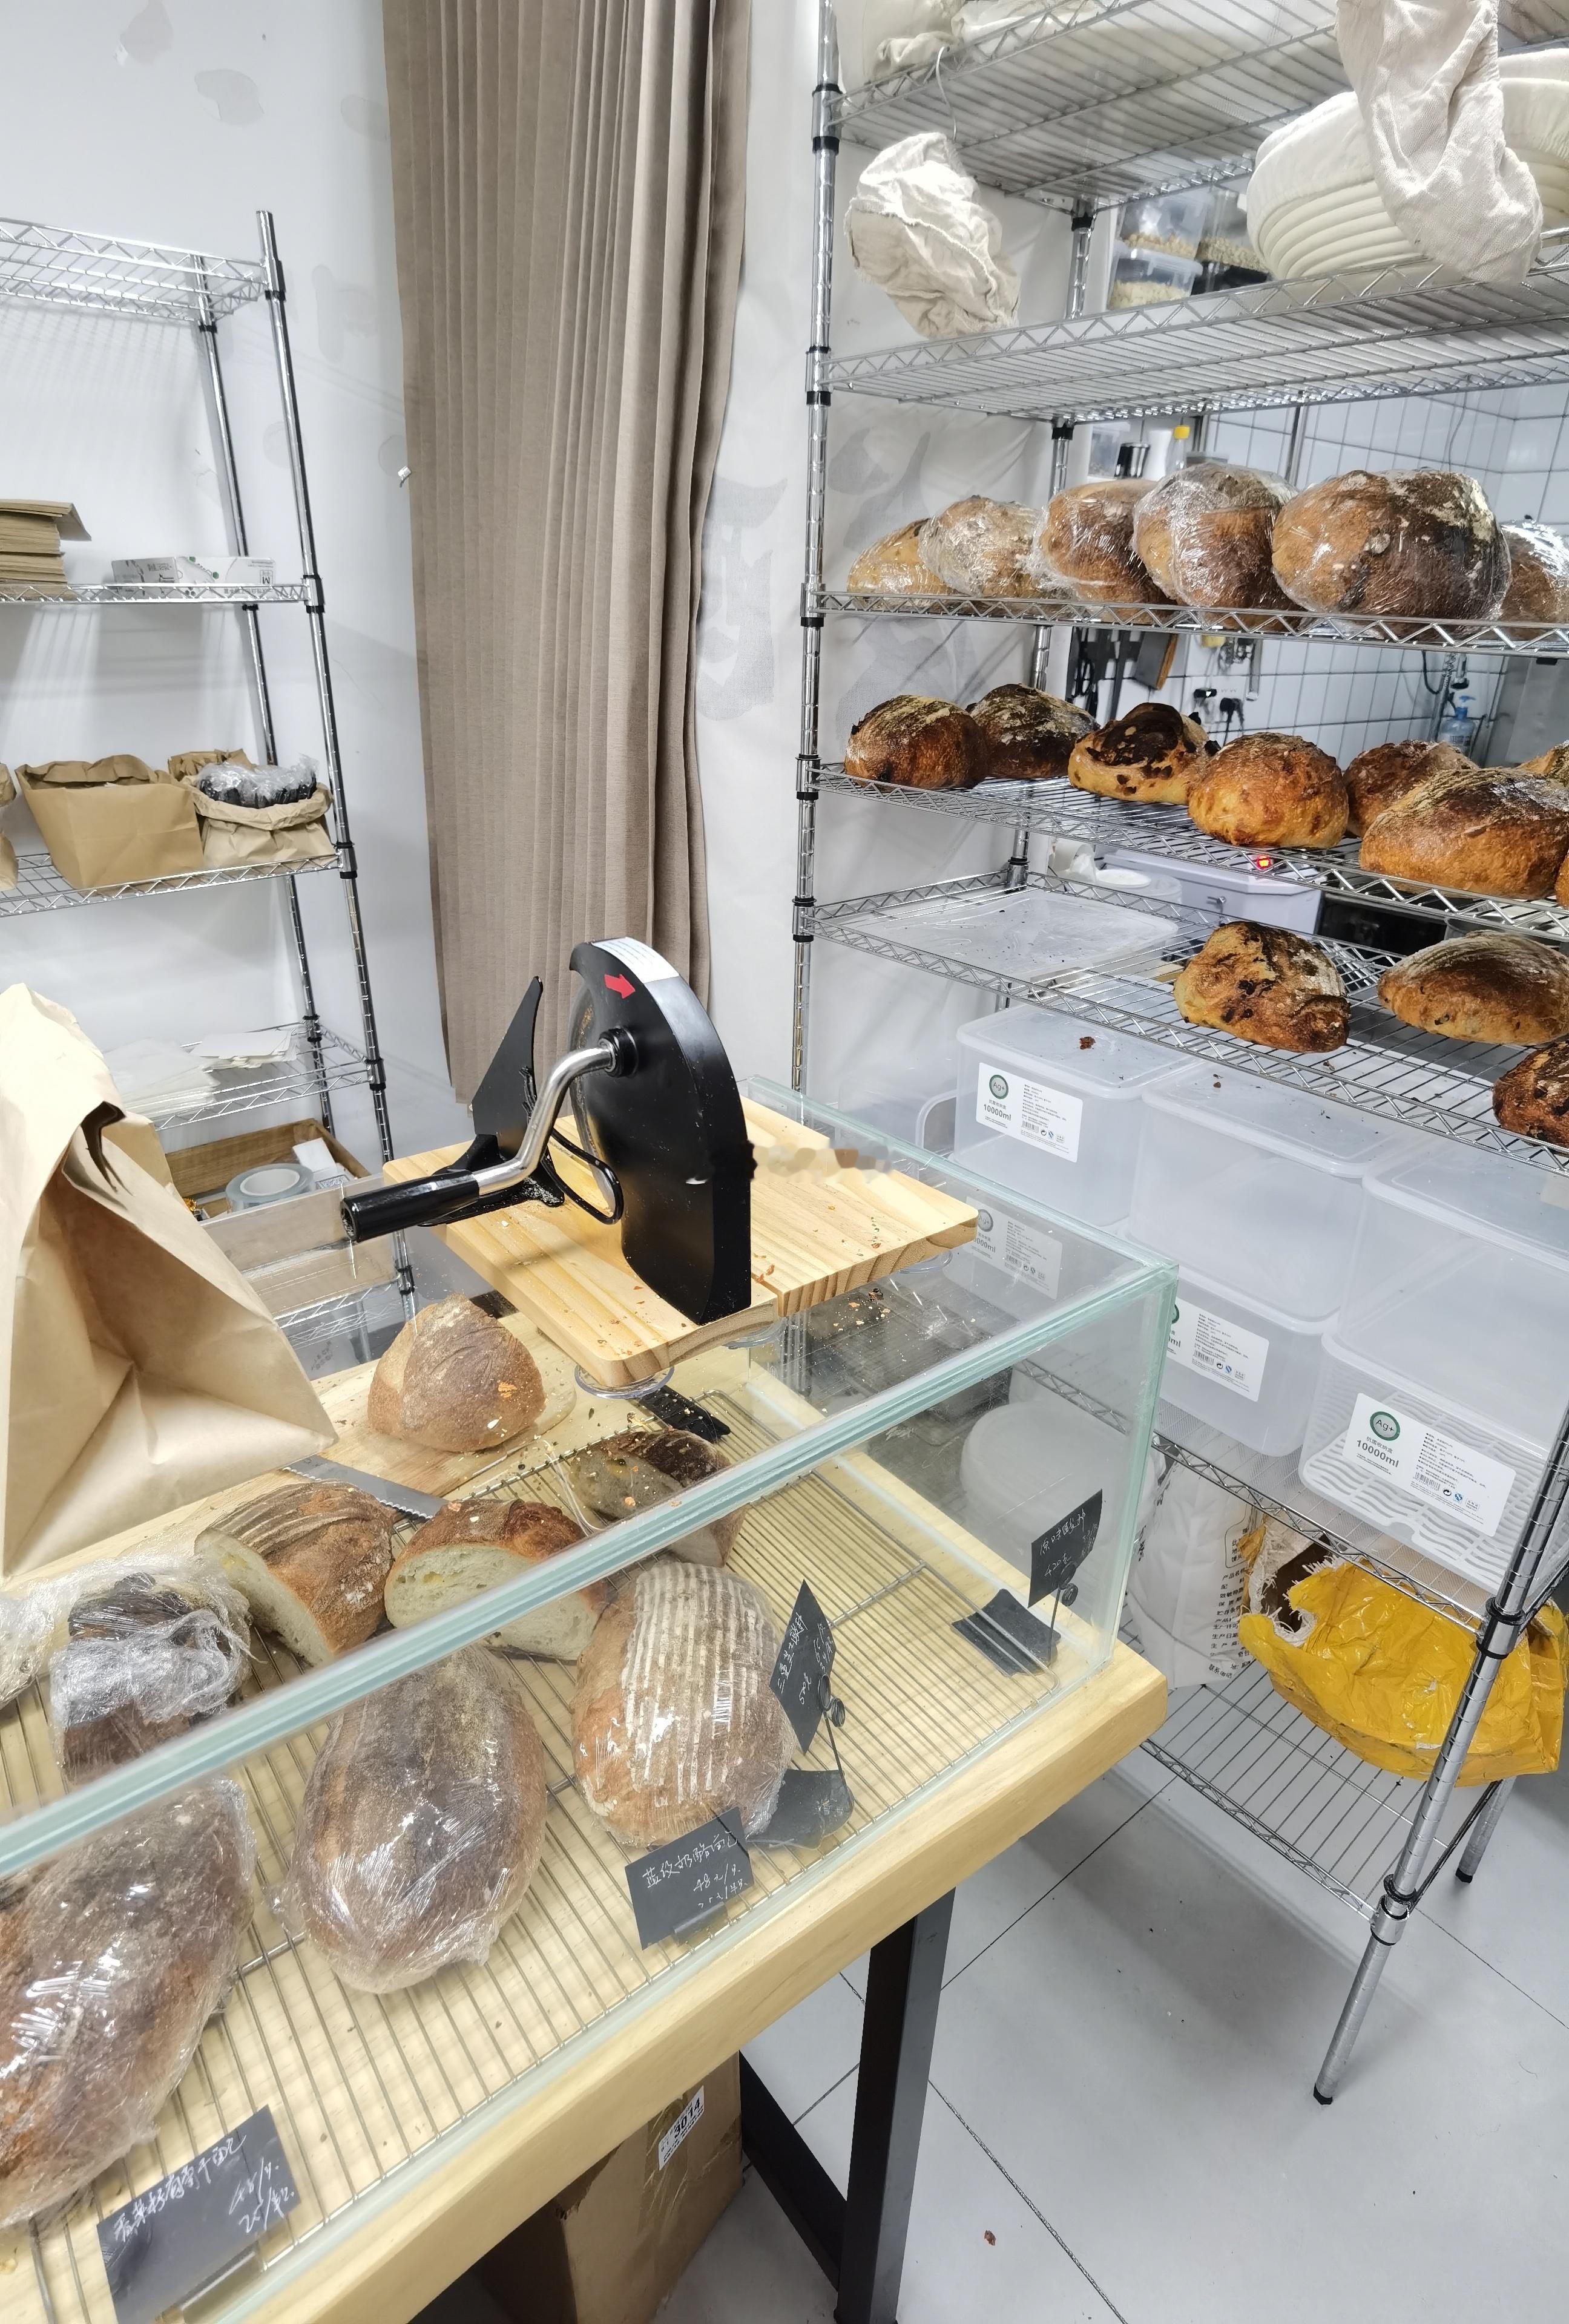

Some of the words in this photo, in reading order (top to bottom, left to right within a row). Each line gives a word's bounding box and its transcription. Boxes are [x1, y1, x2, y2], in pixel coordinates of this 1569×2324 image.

[993, 1082, 1005, 1091] Ag+
[984, 1104, 1011, 1121] 10000ml
[1376, 1419, 1394, 1431] Ag+
[1357, 1440, 1399, 1468] 10000ml
[674, 2097, 700, 2139] 3014
